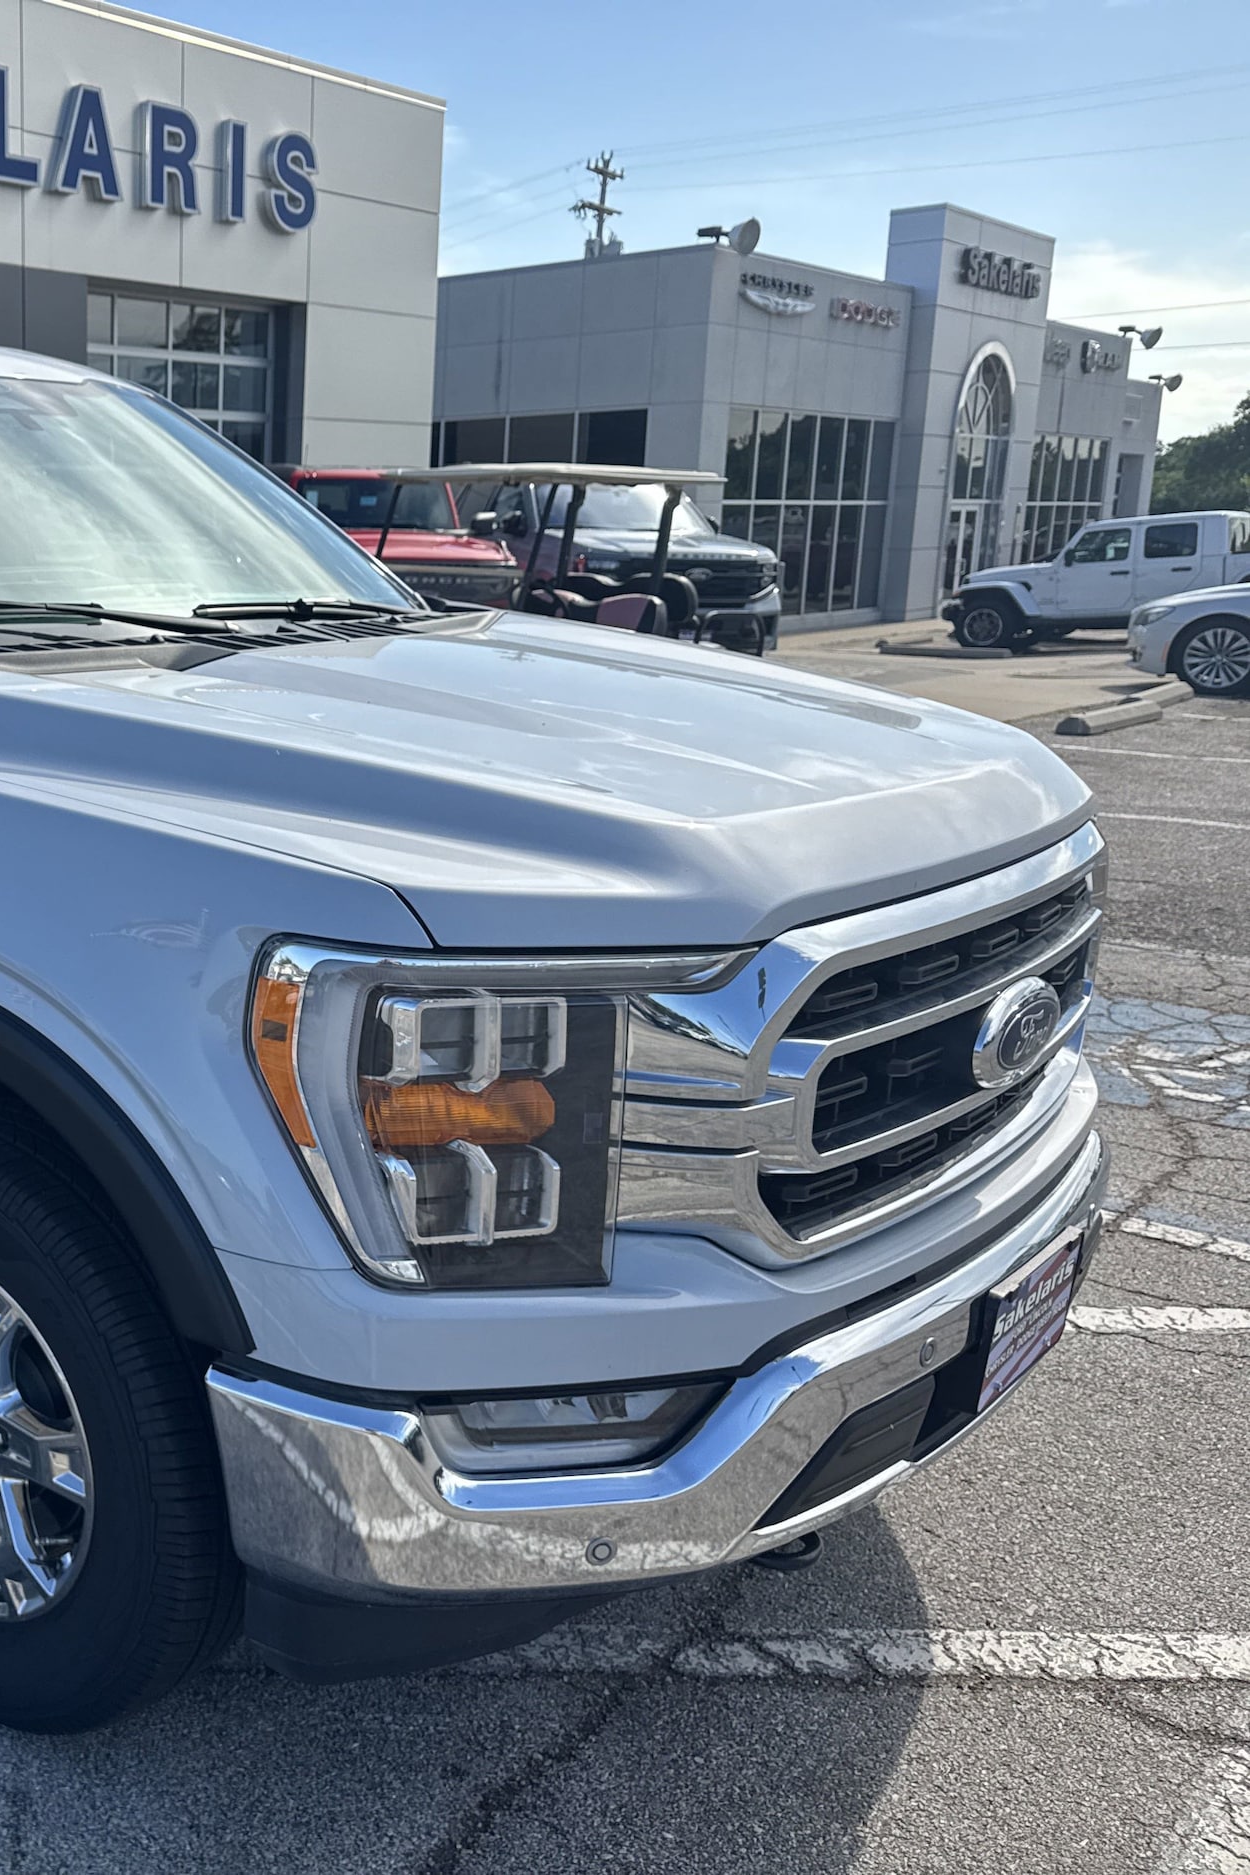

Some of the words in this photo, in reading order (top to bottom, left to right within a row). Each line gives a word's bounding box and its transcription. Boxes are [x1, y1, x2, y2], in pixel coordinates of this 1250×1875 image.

[962, 246, 1042, 298] Sakelaris
[832, 297, 901, 328] DODGE
[991, 1259, 1075, 1342] Sakelaris
